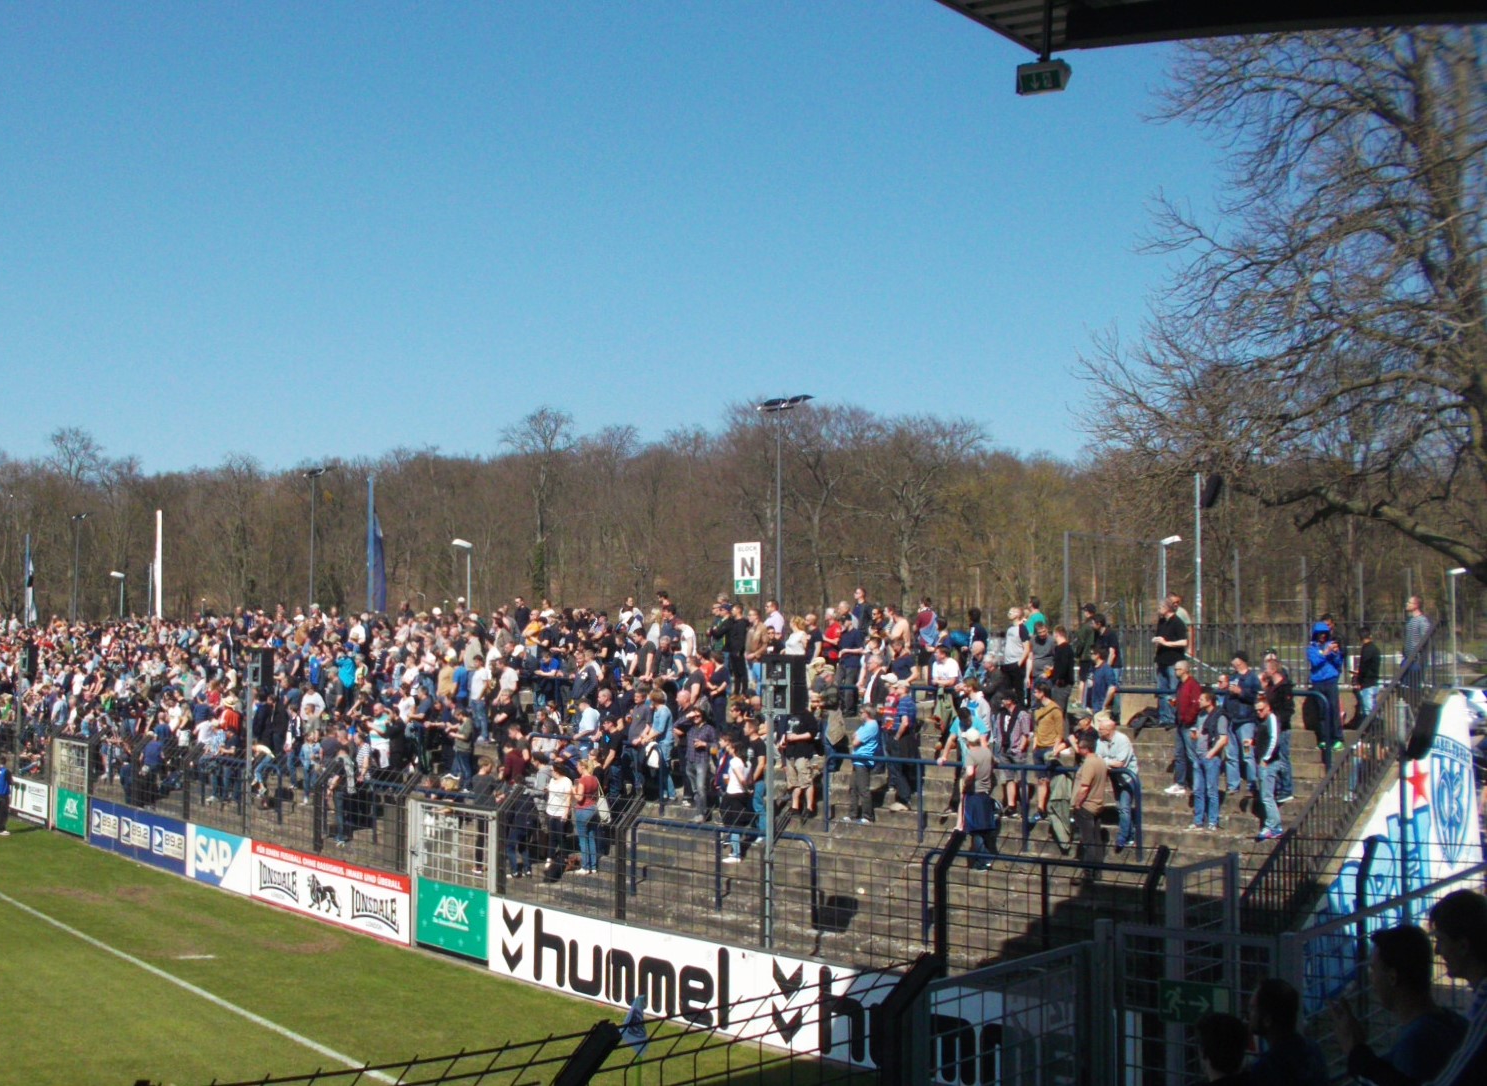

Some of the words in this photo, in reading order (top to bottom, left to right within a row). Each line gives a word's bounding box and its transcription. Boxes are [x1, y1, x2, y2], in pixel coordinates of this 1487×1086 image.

[741, 557, 754, 577] N
[65, 798, 79, 811] AOK
[102, 815, 118, 829] 89.2
[132, 824, 149, 840] 89.2
[164, 833, 183, 850] 89.2
[195, 834, 233, 877] SAP
[259, 860, 299, 898] LONSDALE
[302, 857, 316, 867] OHNE
[346, 868, 363, 880] IMMER
[364, 872, 377, 883] UND
[351, 884, 400, 929] LONSDALE
[433, 895, 469, 925] AOK
[534, 908, 730, 1030] hummel
